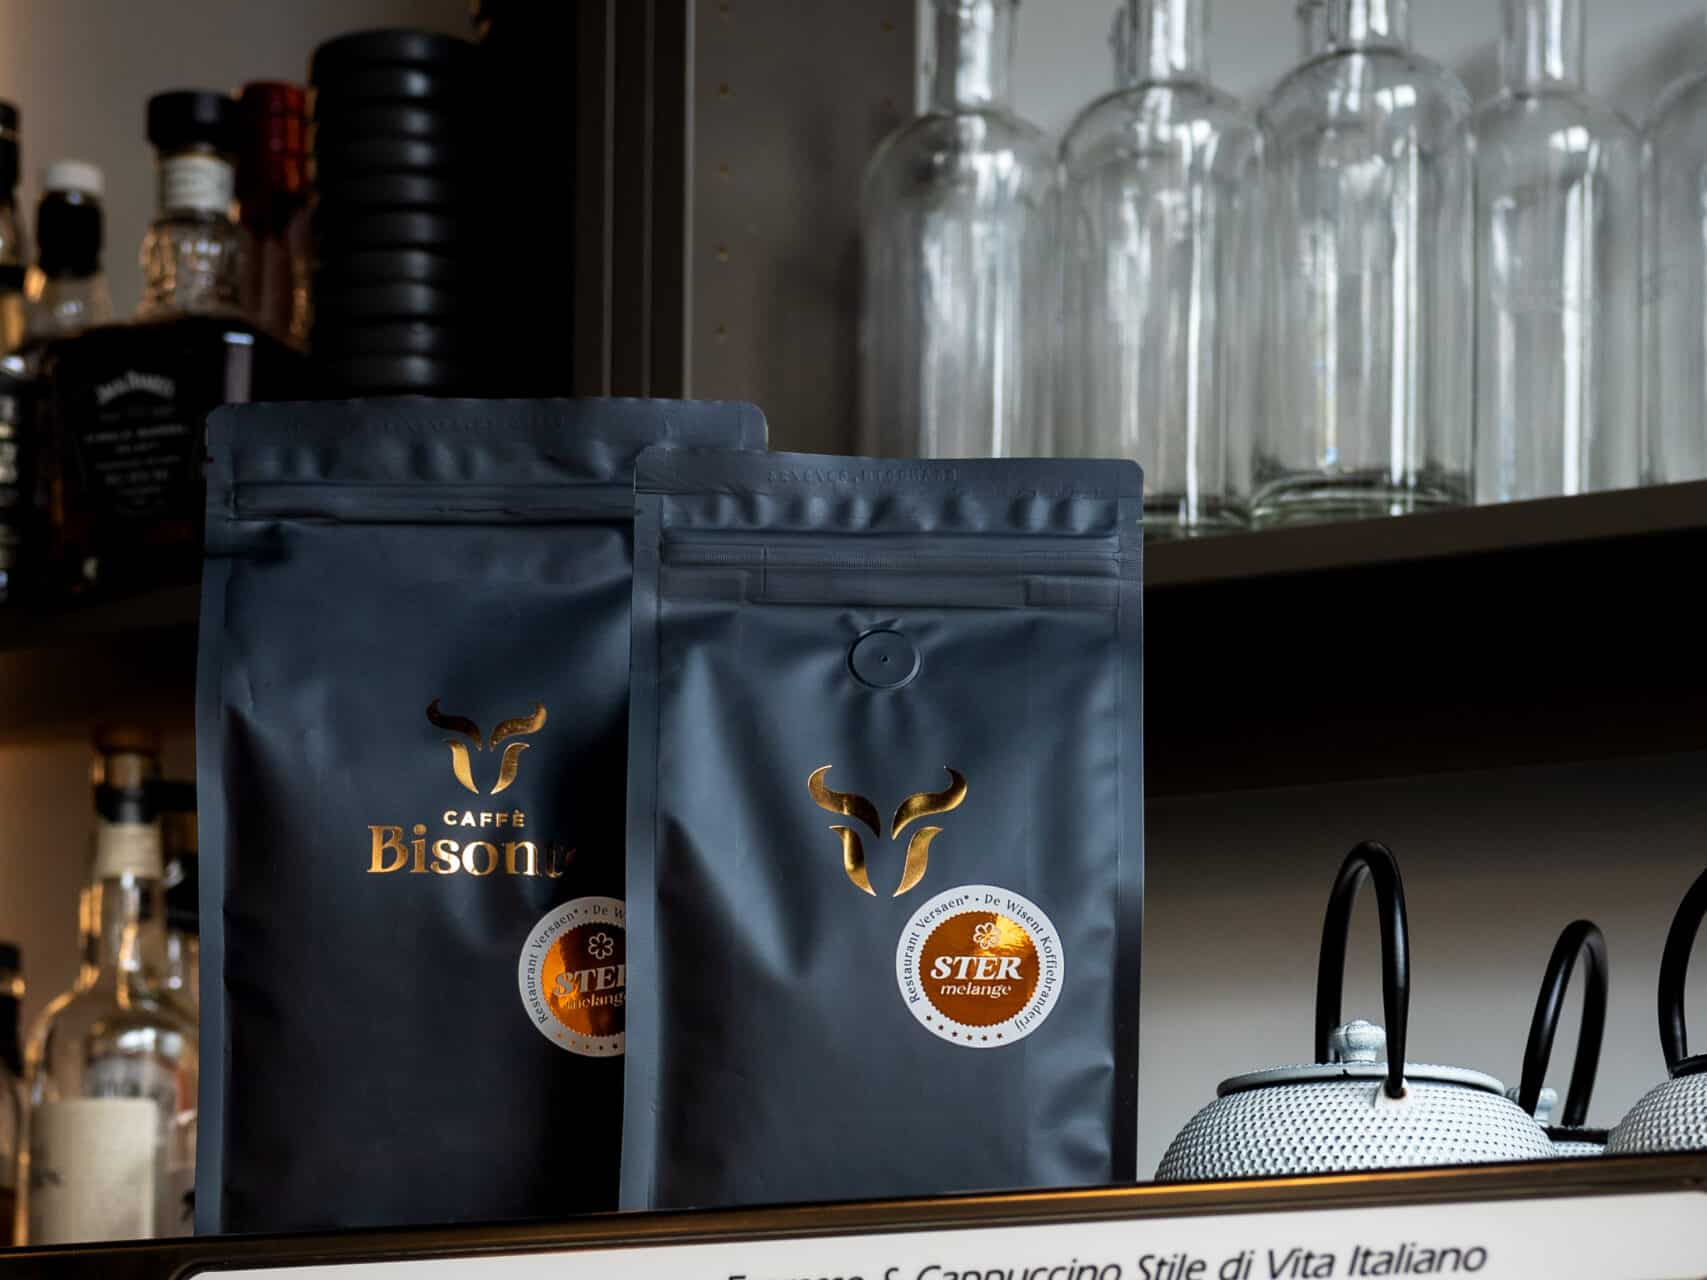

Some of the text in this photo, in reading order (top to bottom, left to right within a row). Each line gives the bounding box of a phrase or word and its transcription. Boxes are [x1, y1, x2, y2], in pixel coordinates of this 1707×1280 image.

[443, 809, 526, 828] CAFFÈ
[593, 904, 608, 916] De
[904, 932, 920, 1004] Restaurant
[930, 955, 1024, 981] STER
[984, 893, 1058, 1032] De Wisent Koffiebranderij
[527, 953, 549, 1024] Restaurant
[566, 992, 627, 1009] melang
[940, 981, 1012, 1000] melange
[1266, 1246, 1337, 1280] Vita
[1346, 1242, 1489, 1277] Italiano
